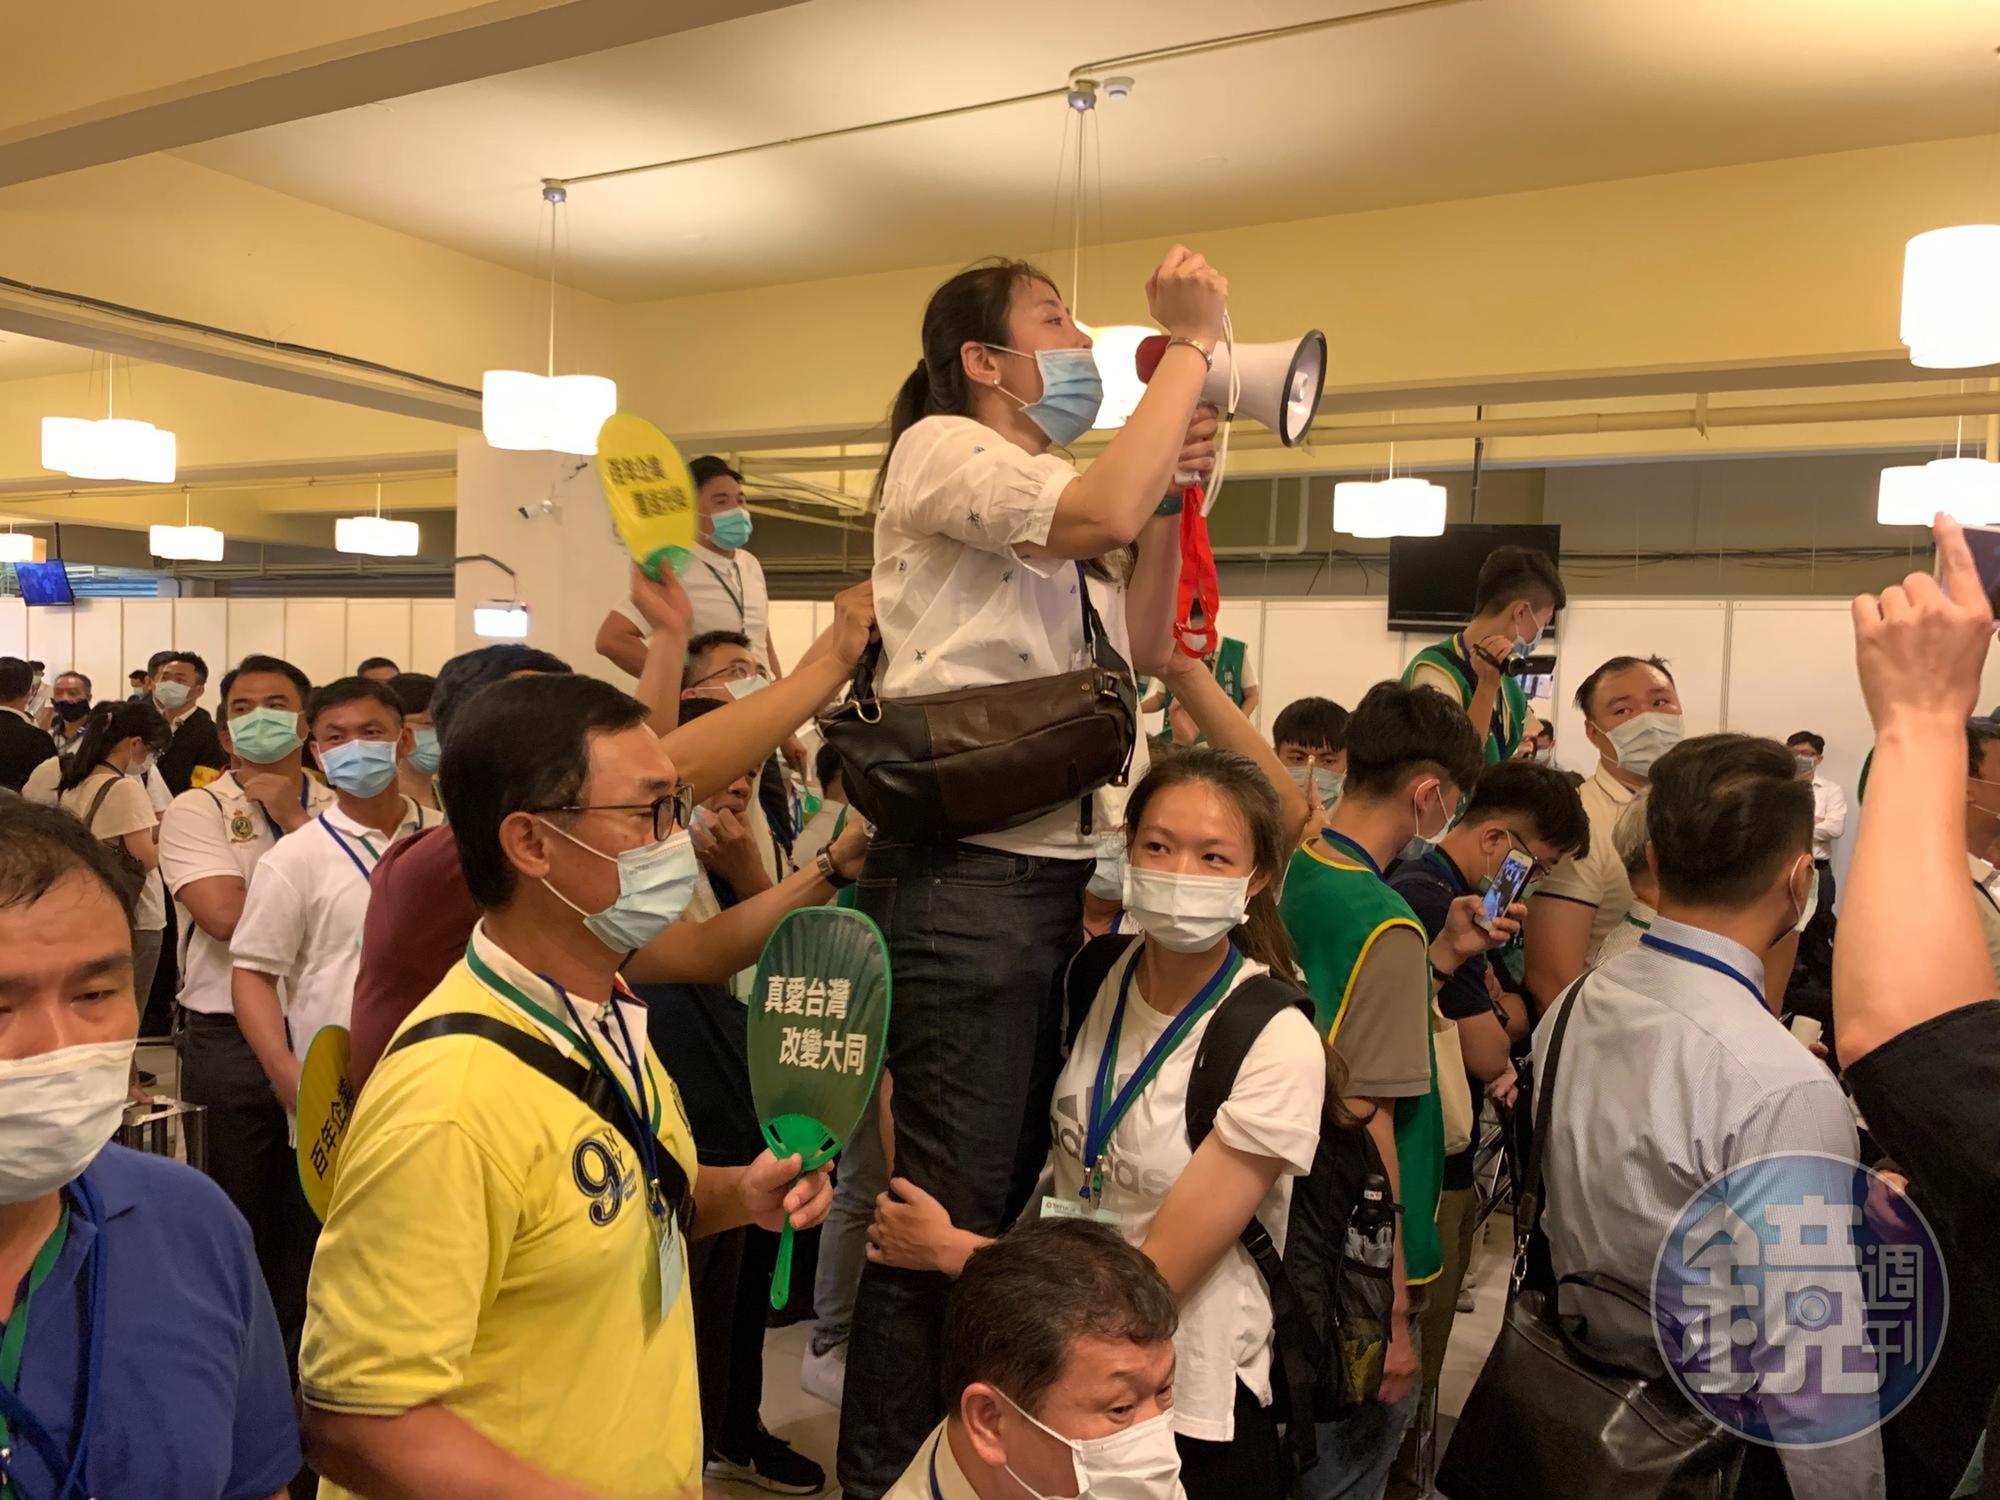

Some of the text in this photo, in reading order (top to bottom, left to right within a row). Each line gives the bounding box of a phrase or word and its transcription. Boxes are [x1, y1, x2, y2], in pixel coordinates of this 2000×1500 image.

[764, 975, 851, 1019] 真愛台灣
[779, 1026, 867, 1075] 改變大同
[571, 1137, 623, 1227] 9
